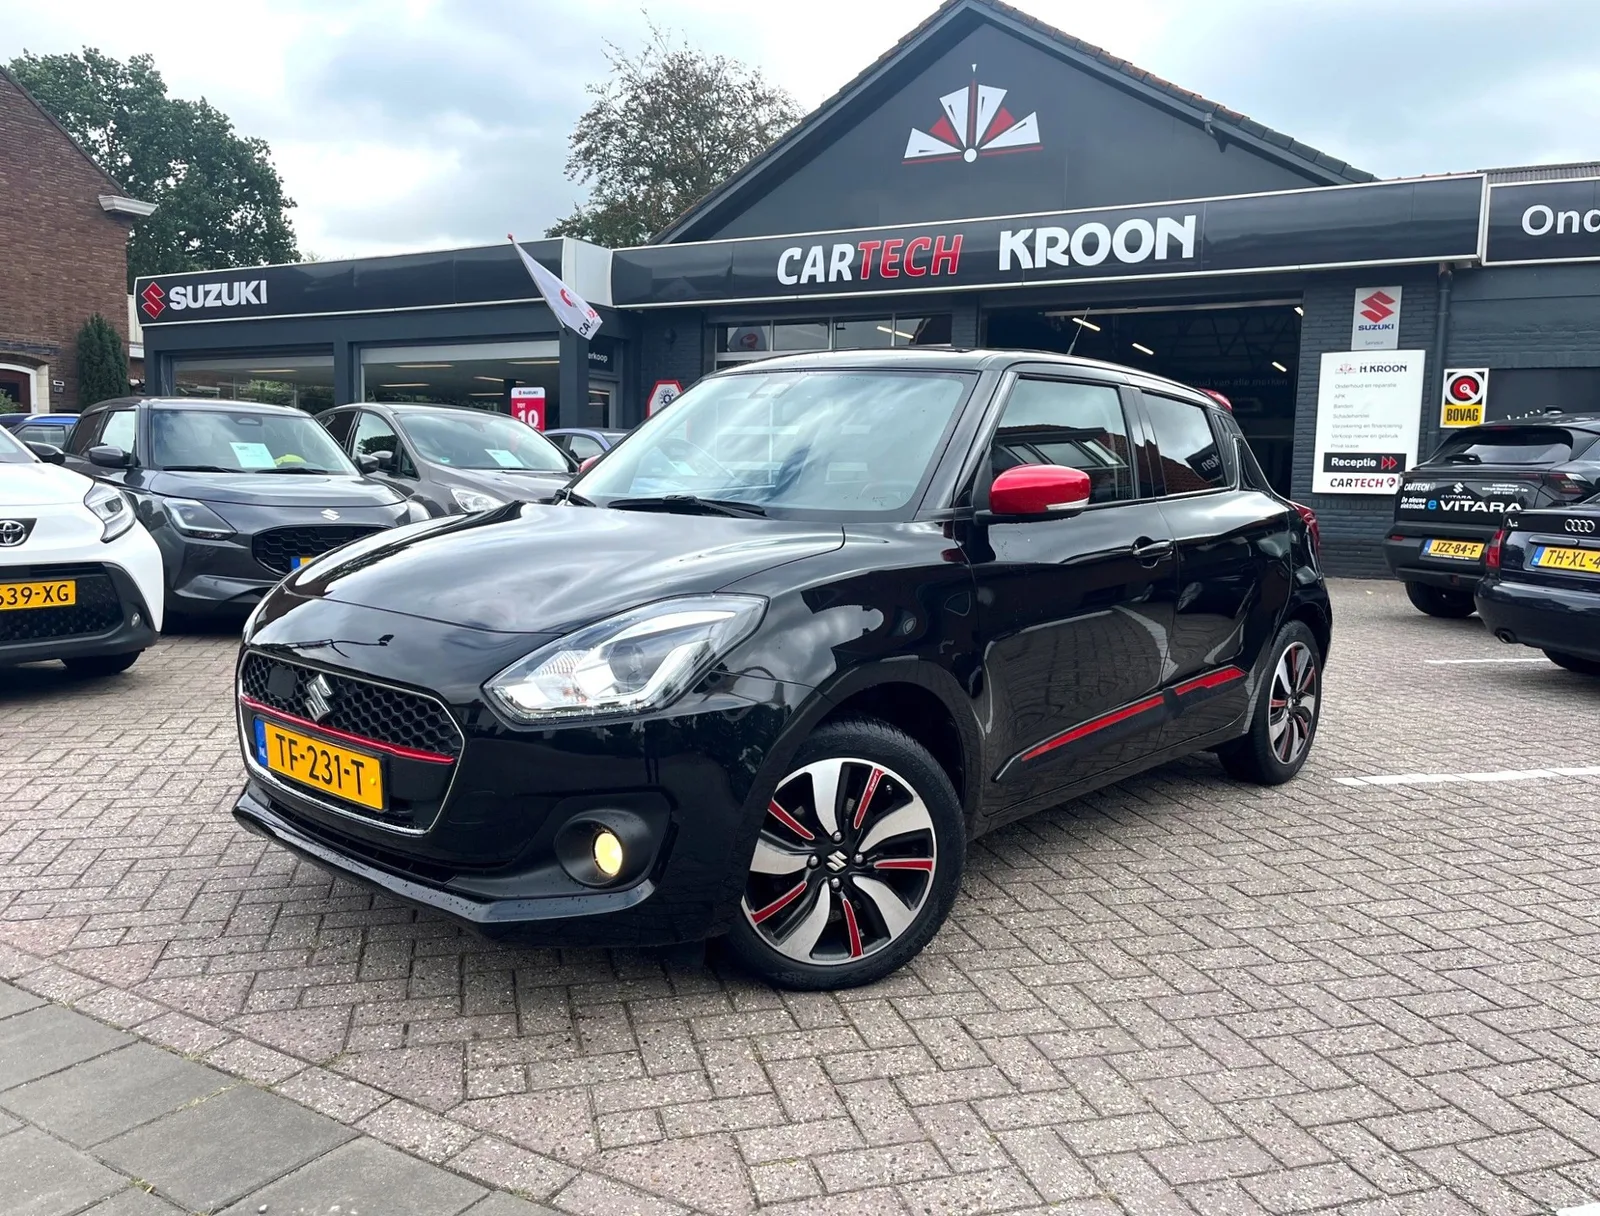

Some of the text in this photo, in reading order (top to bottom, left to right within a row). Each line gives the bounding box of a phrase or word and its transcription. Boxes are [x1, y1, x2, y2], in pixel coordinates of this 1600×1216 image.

[777, 215, 1197, 286] CARTECH KROON
[169, 280, 268, 310] SUZUKI
[1358, 323, 1394, 331] SUZUKI
[588, 352, 608, 363] erkoop
[518, 409, 539, 428] 10
[1446, 408, 1479, 422] BOVAG
[1331, 457, 1377, 468] Receptie
[1330, 478, 1384, 488] CARTECH
[1403, 482, 1431, 491] CARTECH
[1439, 499, 1523, 513] VITARA
[1433, 542, 1479, 555] JZZ-84-F
[275, 733, 365, 796] TF-231-T
